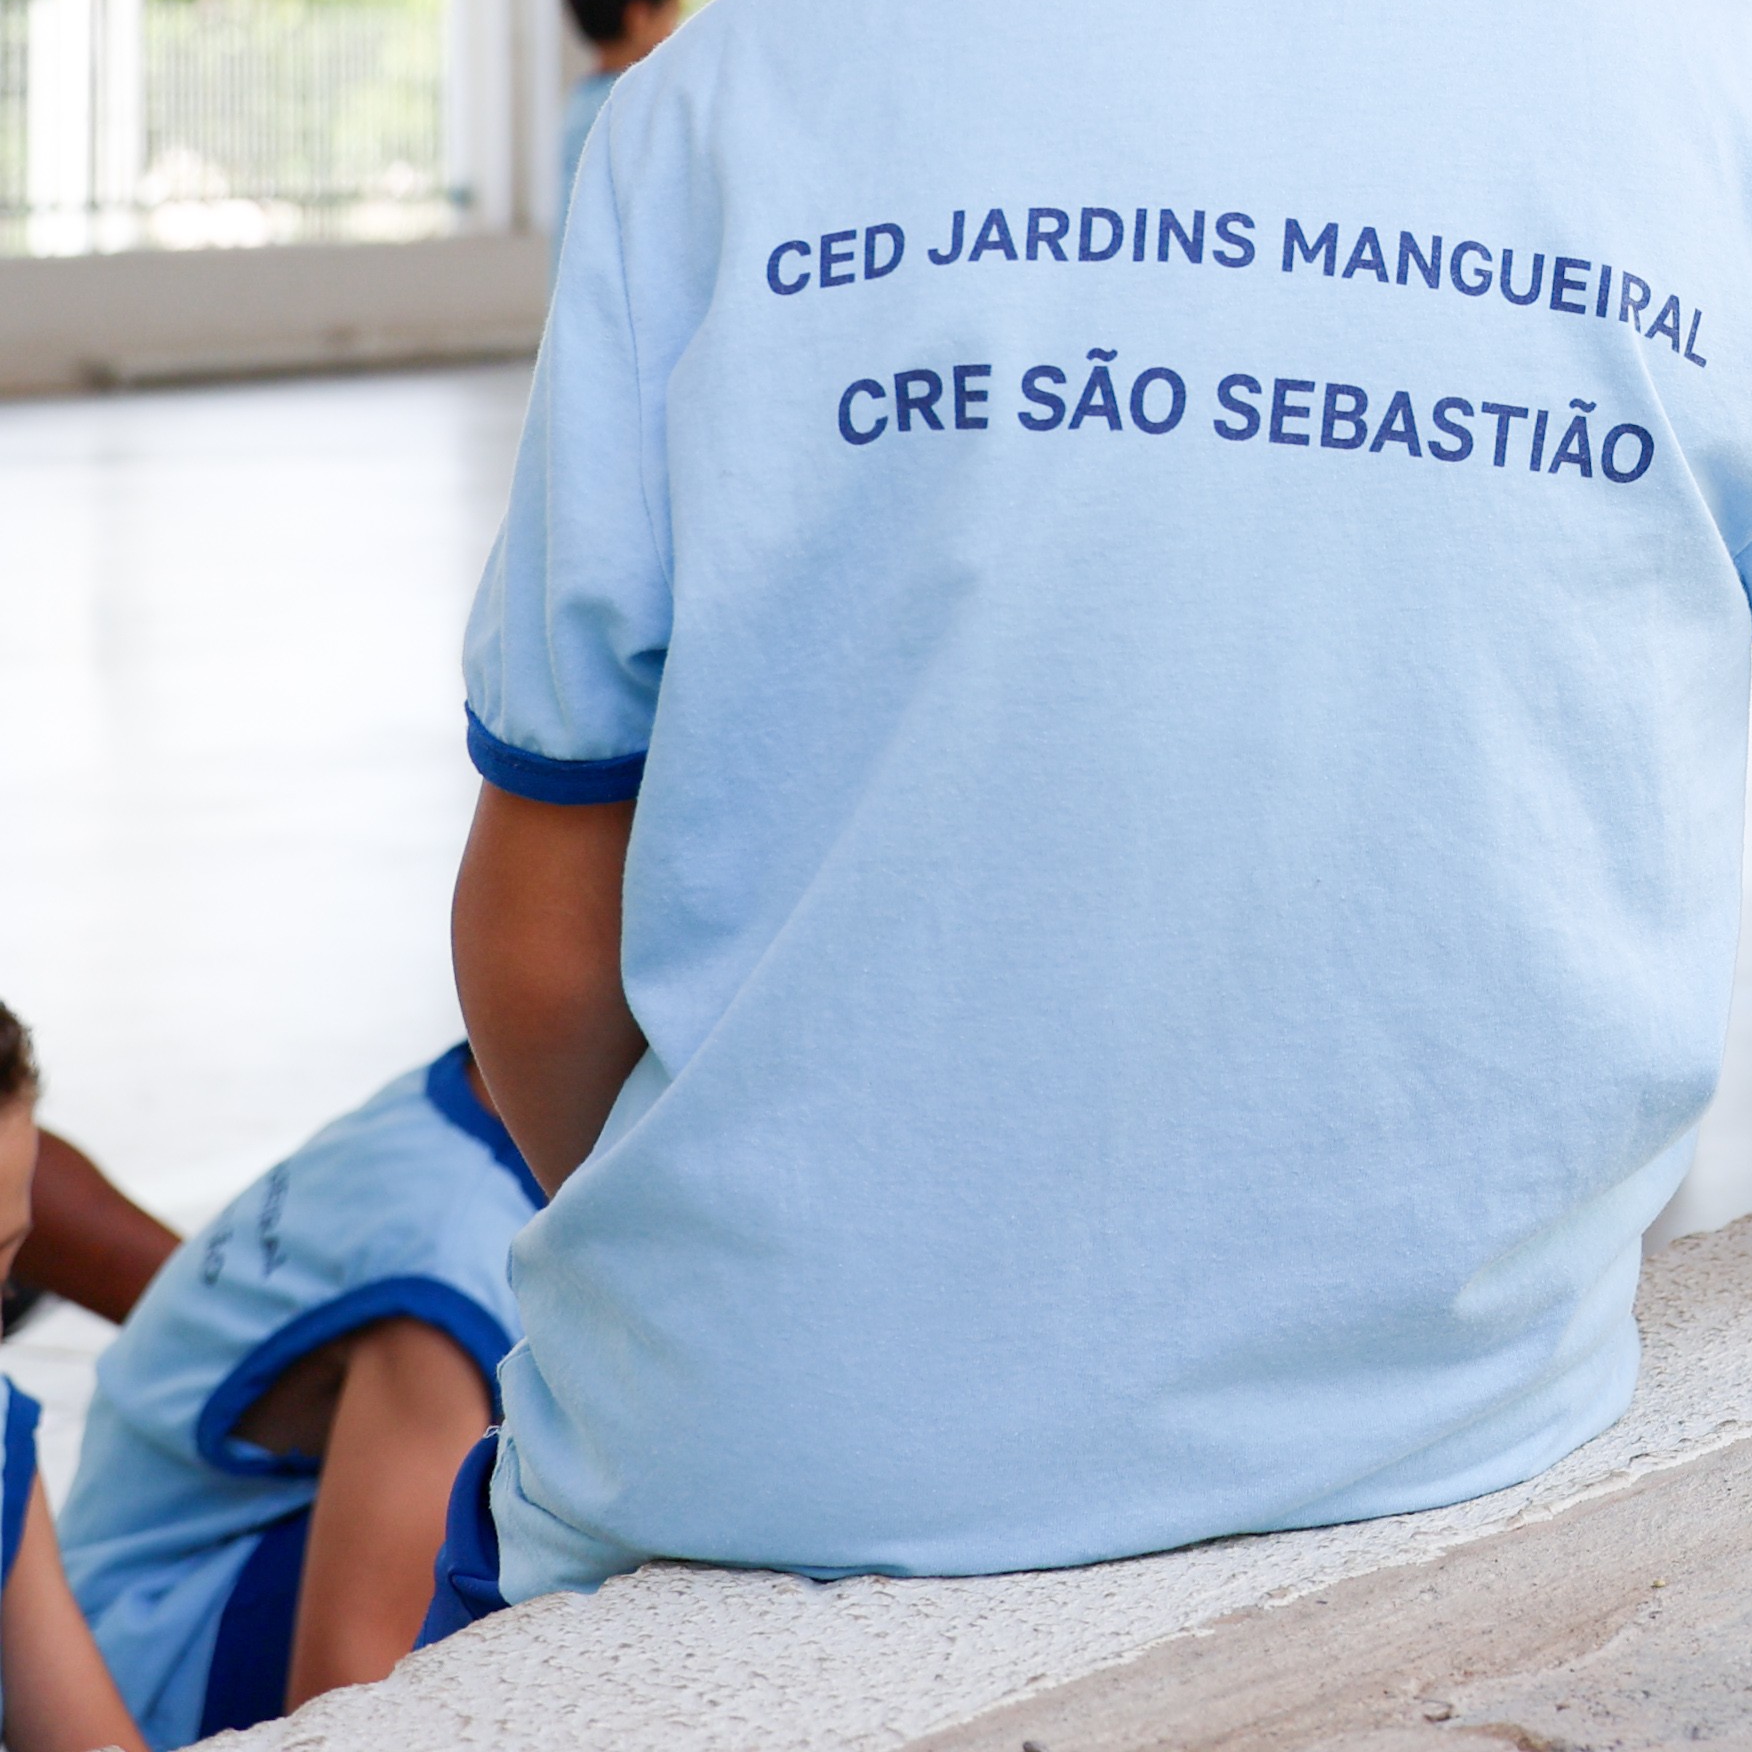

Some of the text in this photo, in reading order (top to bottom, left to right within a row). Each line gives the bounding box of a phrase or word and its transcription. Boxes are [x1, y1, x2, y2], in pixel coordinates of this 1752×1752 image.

[766, 207, 1708, 369] CED JARDINS MANGUEIRAL
[837, 347, 1655, 484] CRE SÃO SEBASTIÃO
